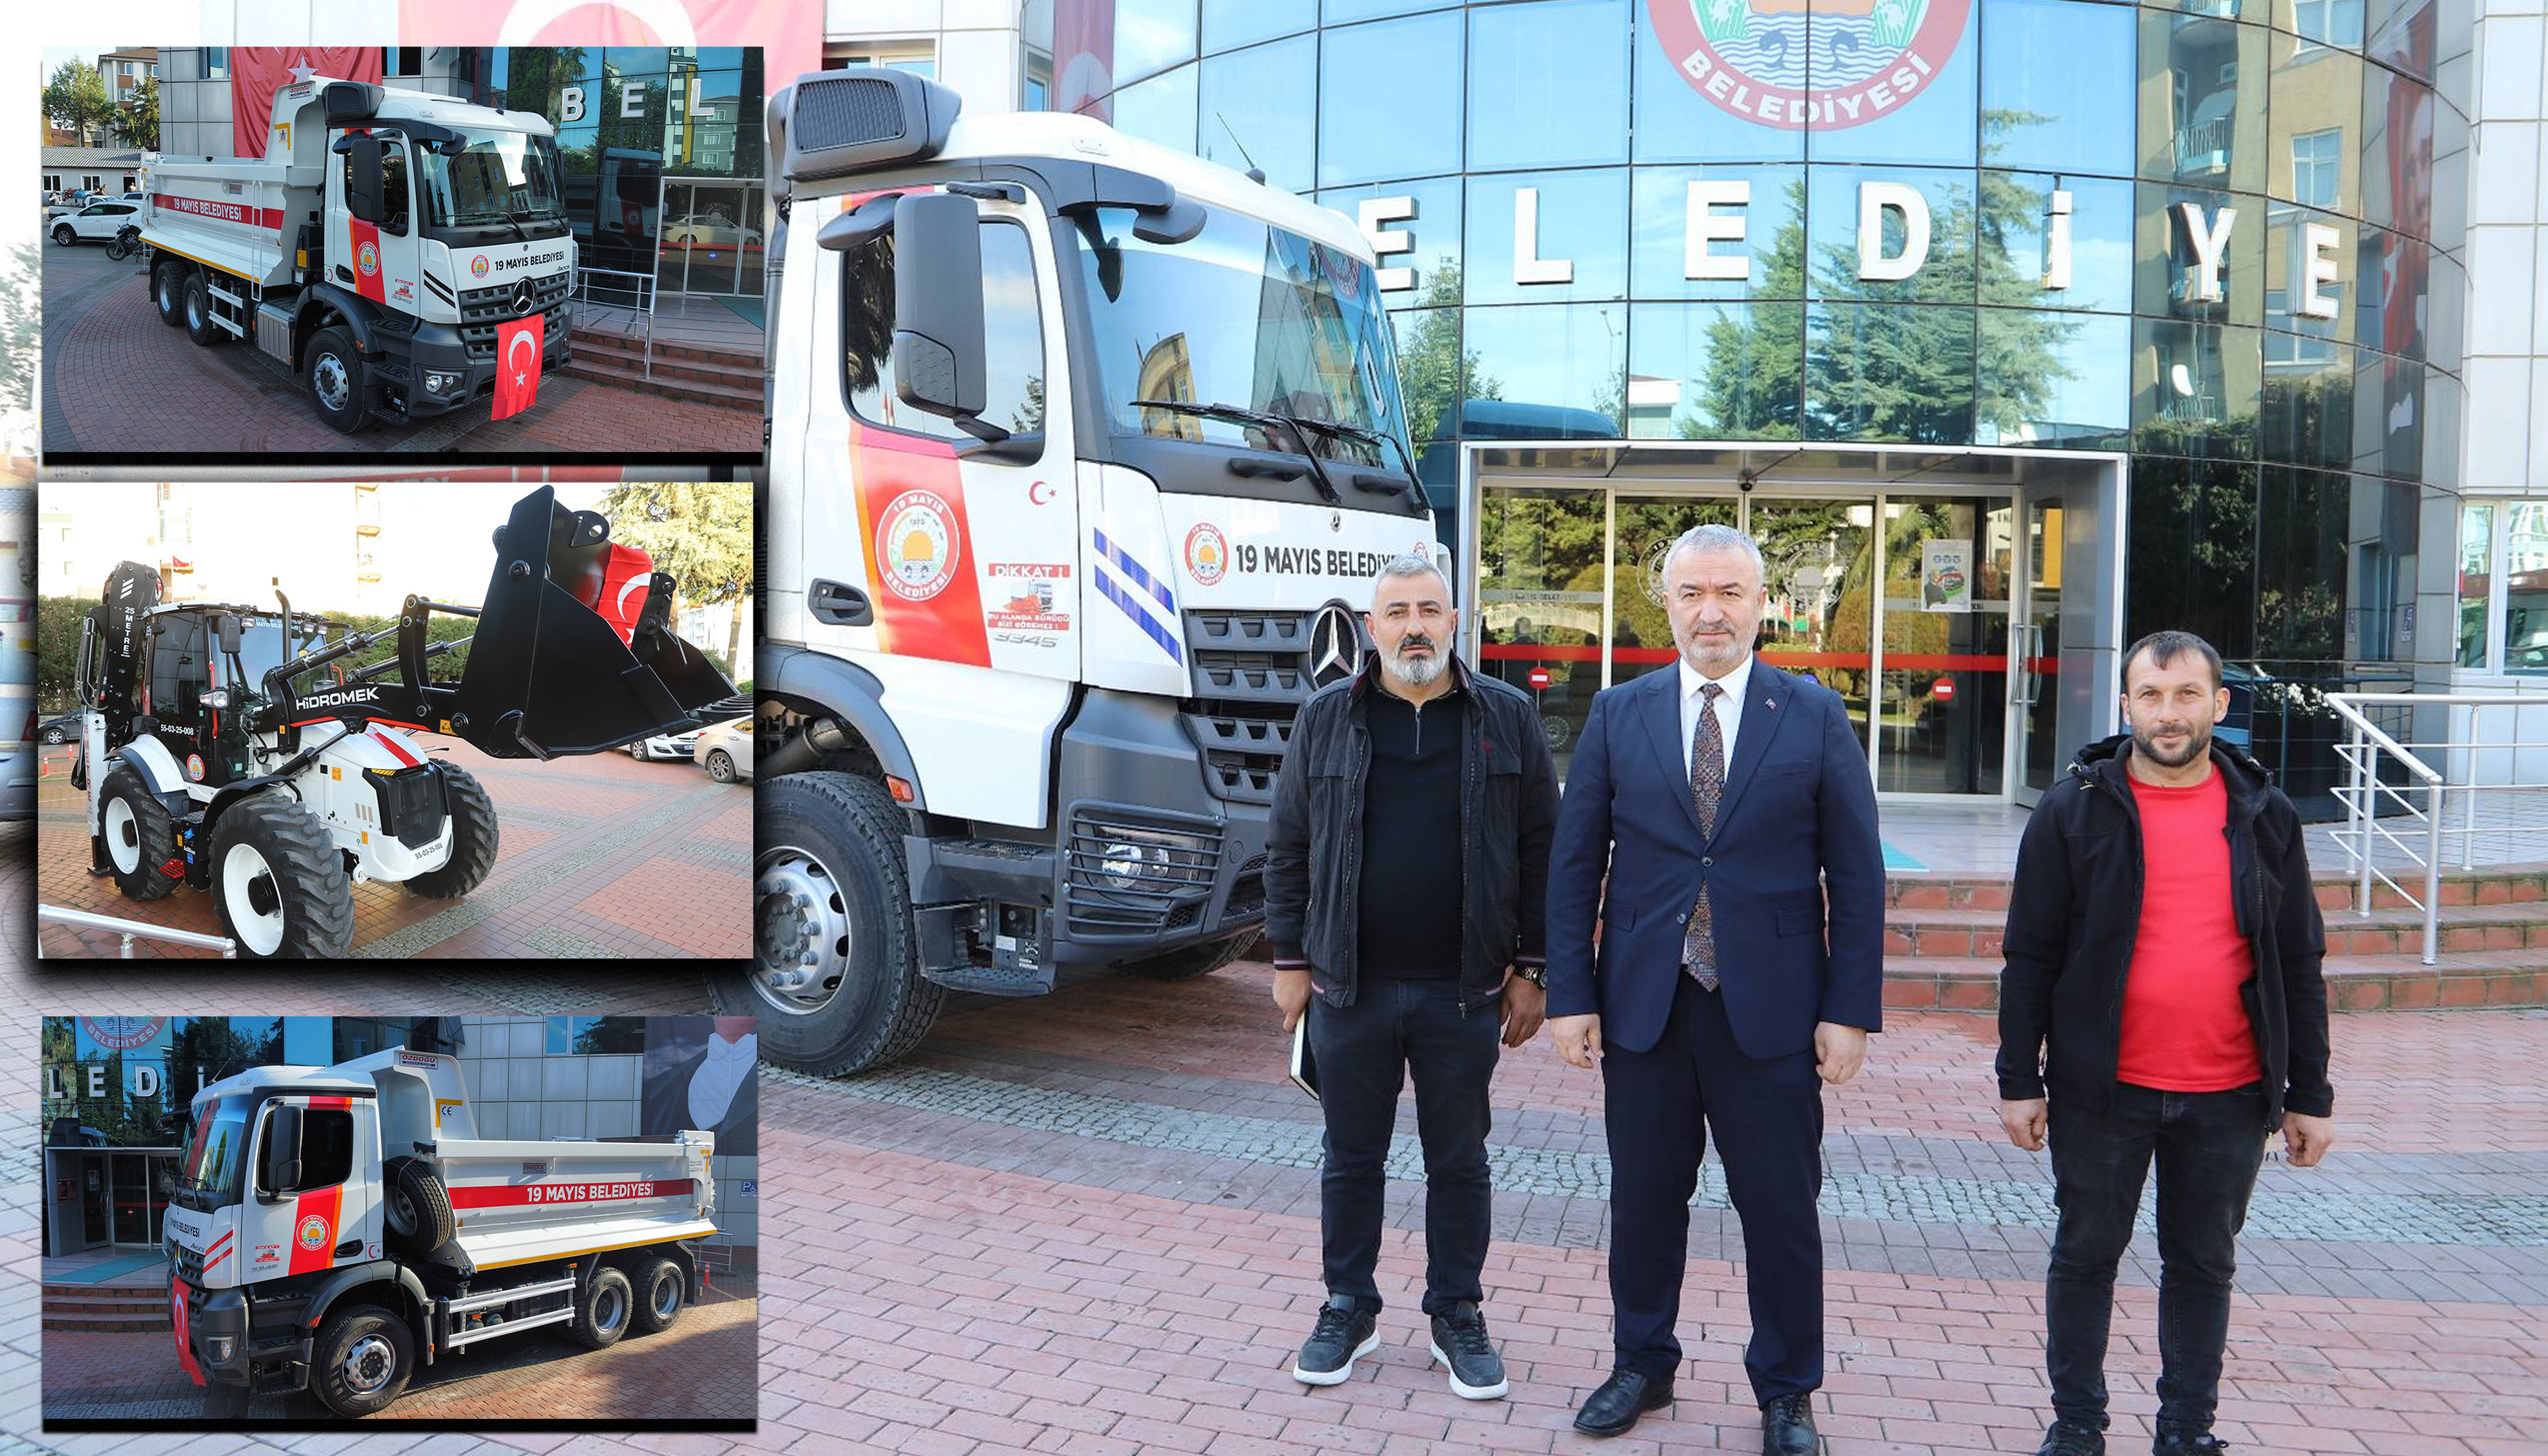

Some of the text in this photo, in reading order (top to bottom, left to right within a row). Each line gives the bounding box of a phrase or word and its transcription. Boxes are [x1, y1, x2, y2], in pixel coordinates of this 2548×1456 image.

[1682, 50, 1932, 124] BELEDİYESİ
[173, 198, 242, 221] 19 MAYIS BELEDİYESİ
[495, 251, 564, 272] 19 MAYIS BELEDİYESİ
[893, 494, 945, 514] 19 MAYIS
[994, 563, 1053, 577] DİKKAT
[1236, 545, 1396, 578] 19 MAYIS BELEDİY
[886, 570, 949, 598] BELEDİYESİ
[124, 606, 135, 614] 25
[296, 687, 380, 711] HİDROMEK
[160, 724, 194, 735] 55-03-25-008
[414, 842, 443, 860] 55-03-25-008
[87, 1023, 159, 1048] BELEDİYESİ
[401, 1053, 435, 1063] ÖZDOĞU
[527, 1182, 654, 1202] 19 MAYIS BELEDİYESİ
